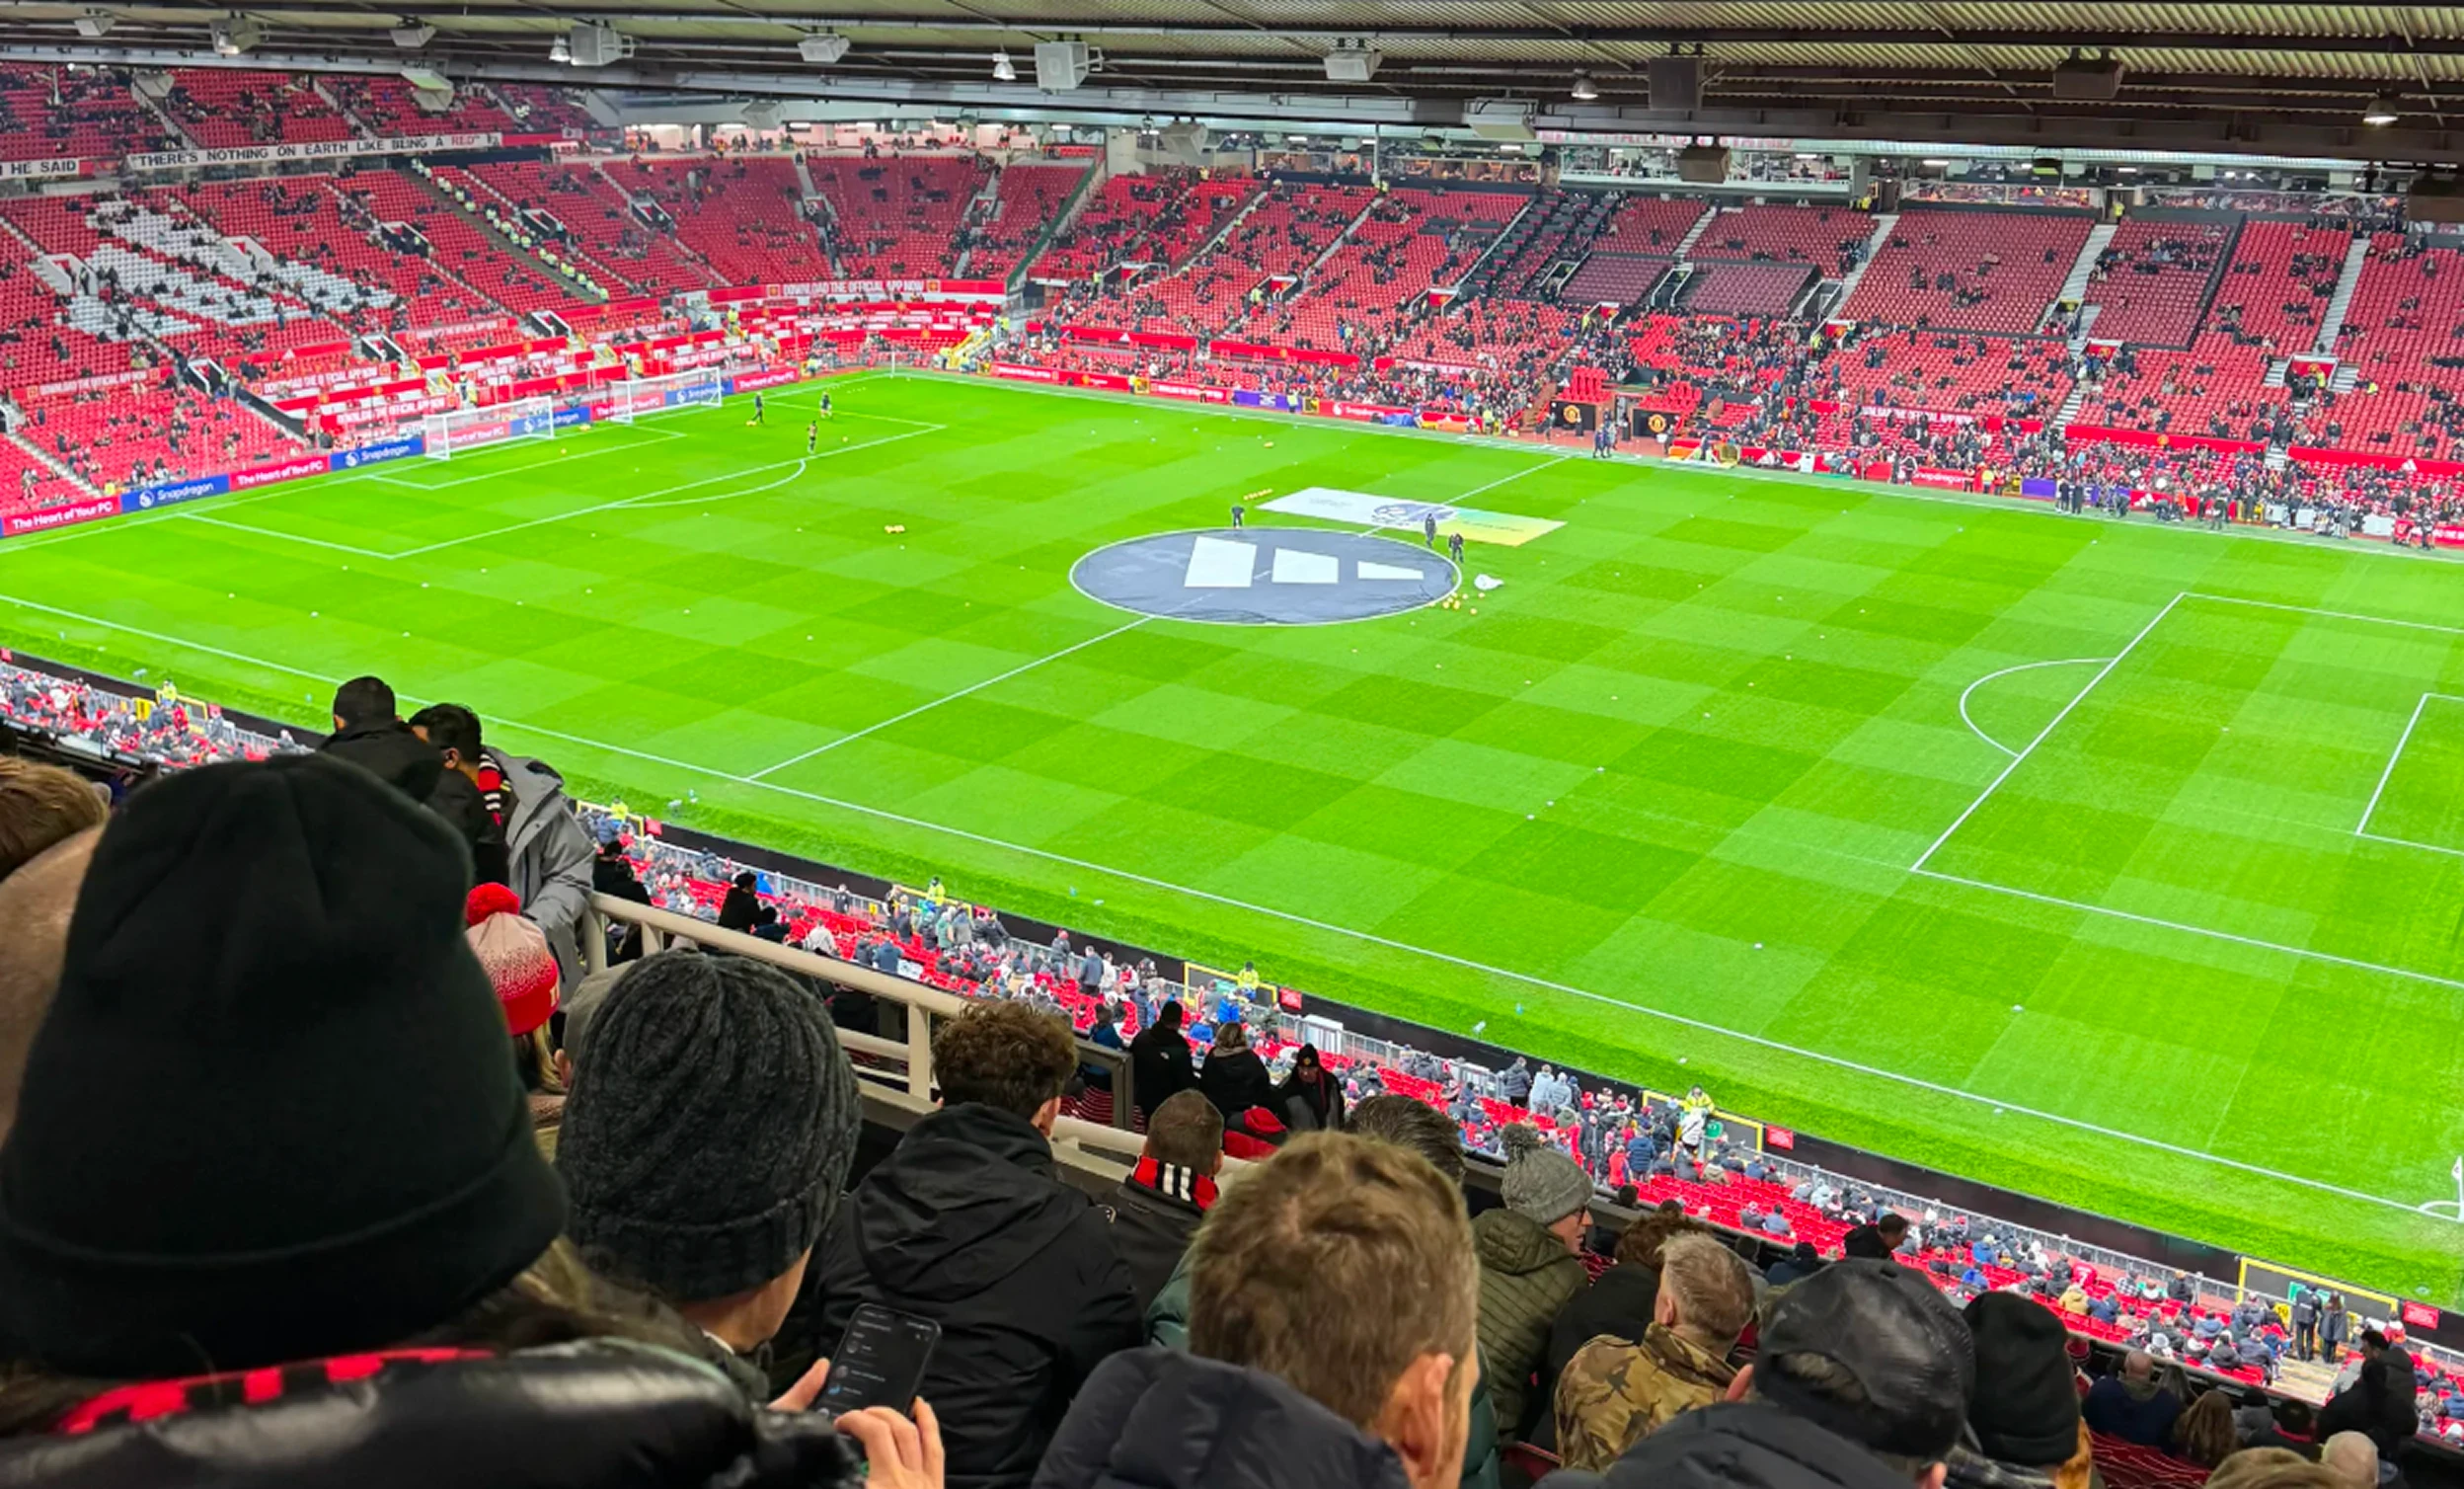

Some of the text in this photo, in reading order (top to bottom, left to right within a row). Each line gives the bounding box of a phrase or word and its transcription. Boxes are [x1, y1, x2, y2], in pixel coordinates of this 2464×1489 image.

[206, 148, 269, 161] NOTHING
[277, 145, 296, 157] ON
[305, 143, 348, 155] EARTH
[356, 140, 384, 151] LIKE
[391, 137, 427, 150] BEING
[435, 136, 444, 146] A
[11, 162, 32, 174] HE
[40, 160, 76, 173] SAID
[361, 444, 410, 461] Snapdragon
[237, 460, 324, 485] The Heart of Your PC
[157, 482, 214, 502] Snapdragon
[12, 501, 113, 530] The Heart of Your PC
